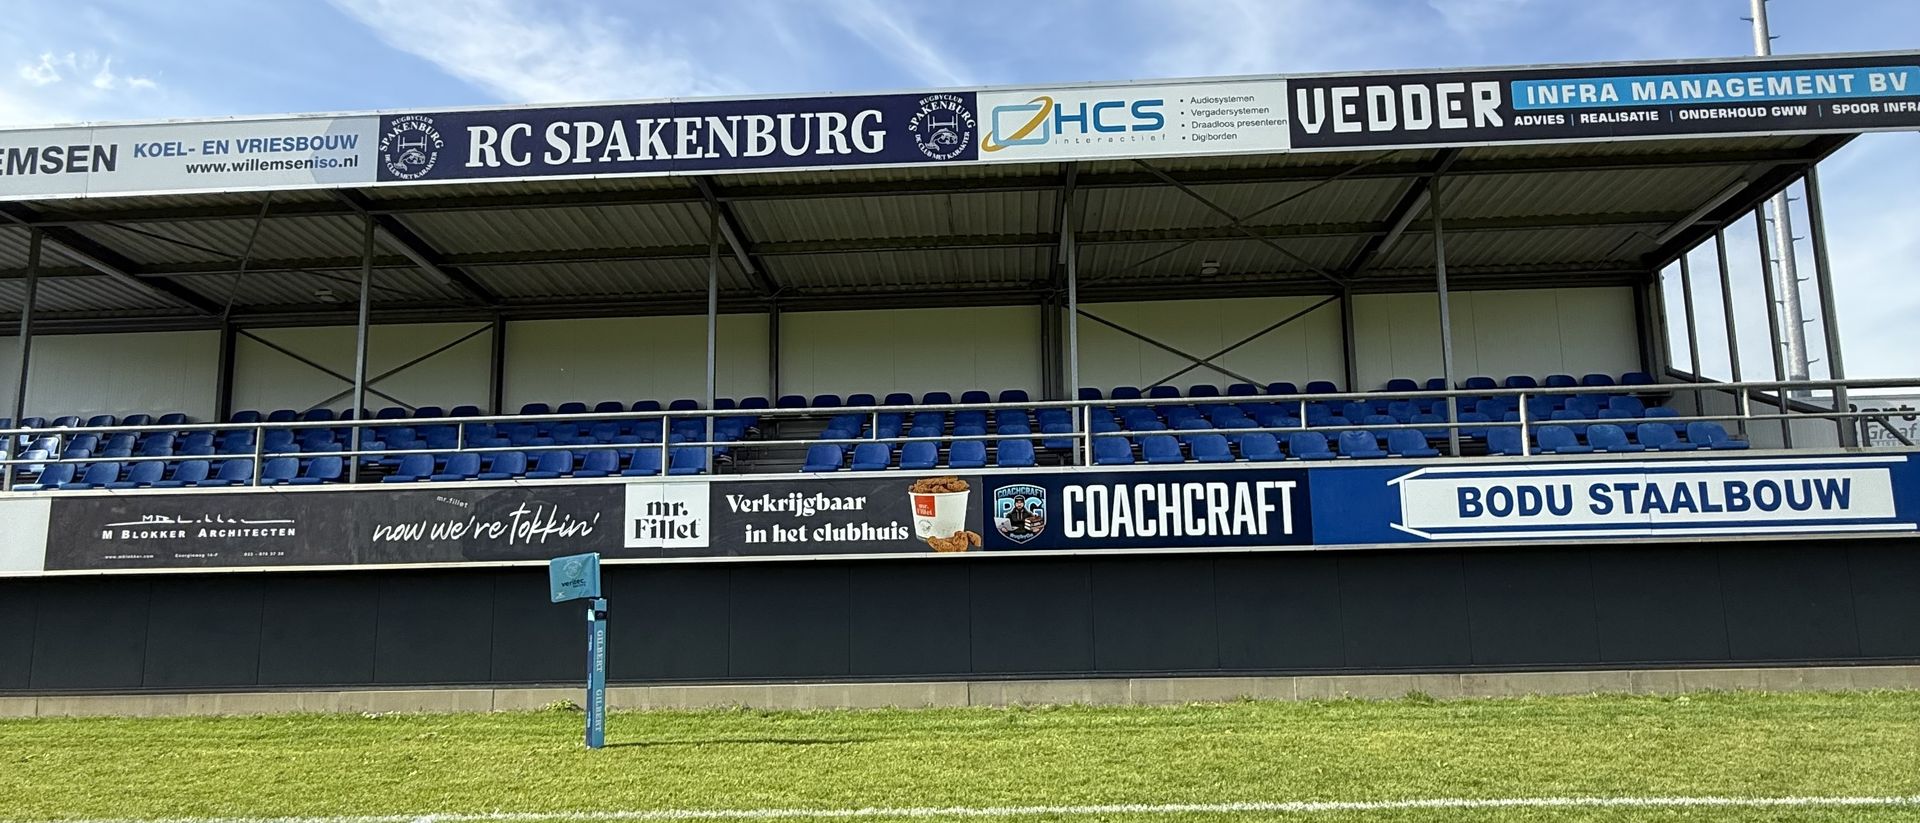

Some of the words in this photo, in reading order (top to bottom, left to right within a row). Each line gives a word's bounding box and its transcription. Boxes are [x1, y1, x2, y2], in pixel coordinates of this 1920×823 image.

[1527, 82, 1619, 105] INFRA
[1632, 73, 1855, 101] MANAGEMENT
[1868, 71, 1908, 92] BV
[919, 94, 964, 106] RUGBYCLUB
[1190, 95, 1255, 105] Audiosystemen
[1296, 81, 1504, 134] VEDDER
[391, 115, 433, 126] RUGBYCLUB
[908, 101, 976, 132] SPAKENBURG
[1055, 99, 1165, 135] HCS
[1191, 107, 1270, 118] Vergadersystemen
[1191, 120, 1235, 129] Draadloos
[1237, 118, 1288, 129] presenteren
[1514, 114, 1565, 126] ADVIES
[1580, 111, 1660, 124] REALISATIE
[1679, 106, 1767, 120] ONDERHOUD
[1771, 105, 1808, 117] GWW
[1832, 103, 1880, 115] SPOOR
[1884, 102, 1920, 113] INFR
[134, 142, 195, 158] KOEL-
[202, 140, 229, 155] EN
[237, 135, 359, 153] VRIESBOUW
[380, 121, 444, 152] SPAKENBURG
[465, 123, 532, 168] RC
[544, 110, 886, 165] SPAKENBURG
[1055, 133, 1166, 145] interactief
[1192, 132, 1238, 142] Digiborden
[0, 144, 118, 176] MSEN
[186, 155, 358, 174] www.willemseniso.nl
[436, 495, 468, 508] mr.fillet
[998, 487, 1042, 498] COACHCRAFT
[1457, 484, 1573, 519] BODU
[1589, 477, 1851, 515] STAALBOUW
[646, 501, 688, 516] mr.
[726, 493, 866, 517] Verkrijgbaar
[1063, 480, 1297, 538] COACHCRAFT
[102, 530, 113, 540] M
[372, 519, 427, 542] now
[634, 518, 701, 540] Fillet
[745, 524, 767, 543] in
[772, 524, 808, 543] het
[813, 520, 909, 542] clubhuis
